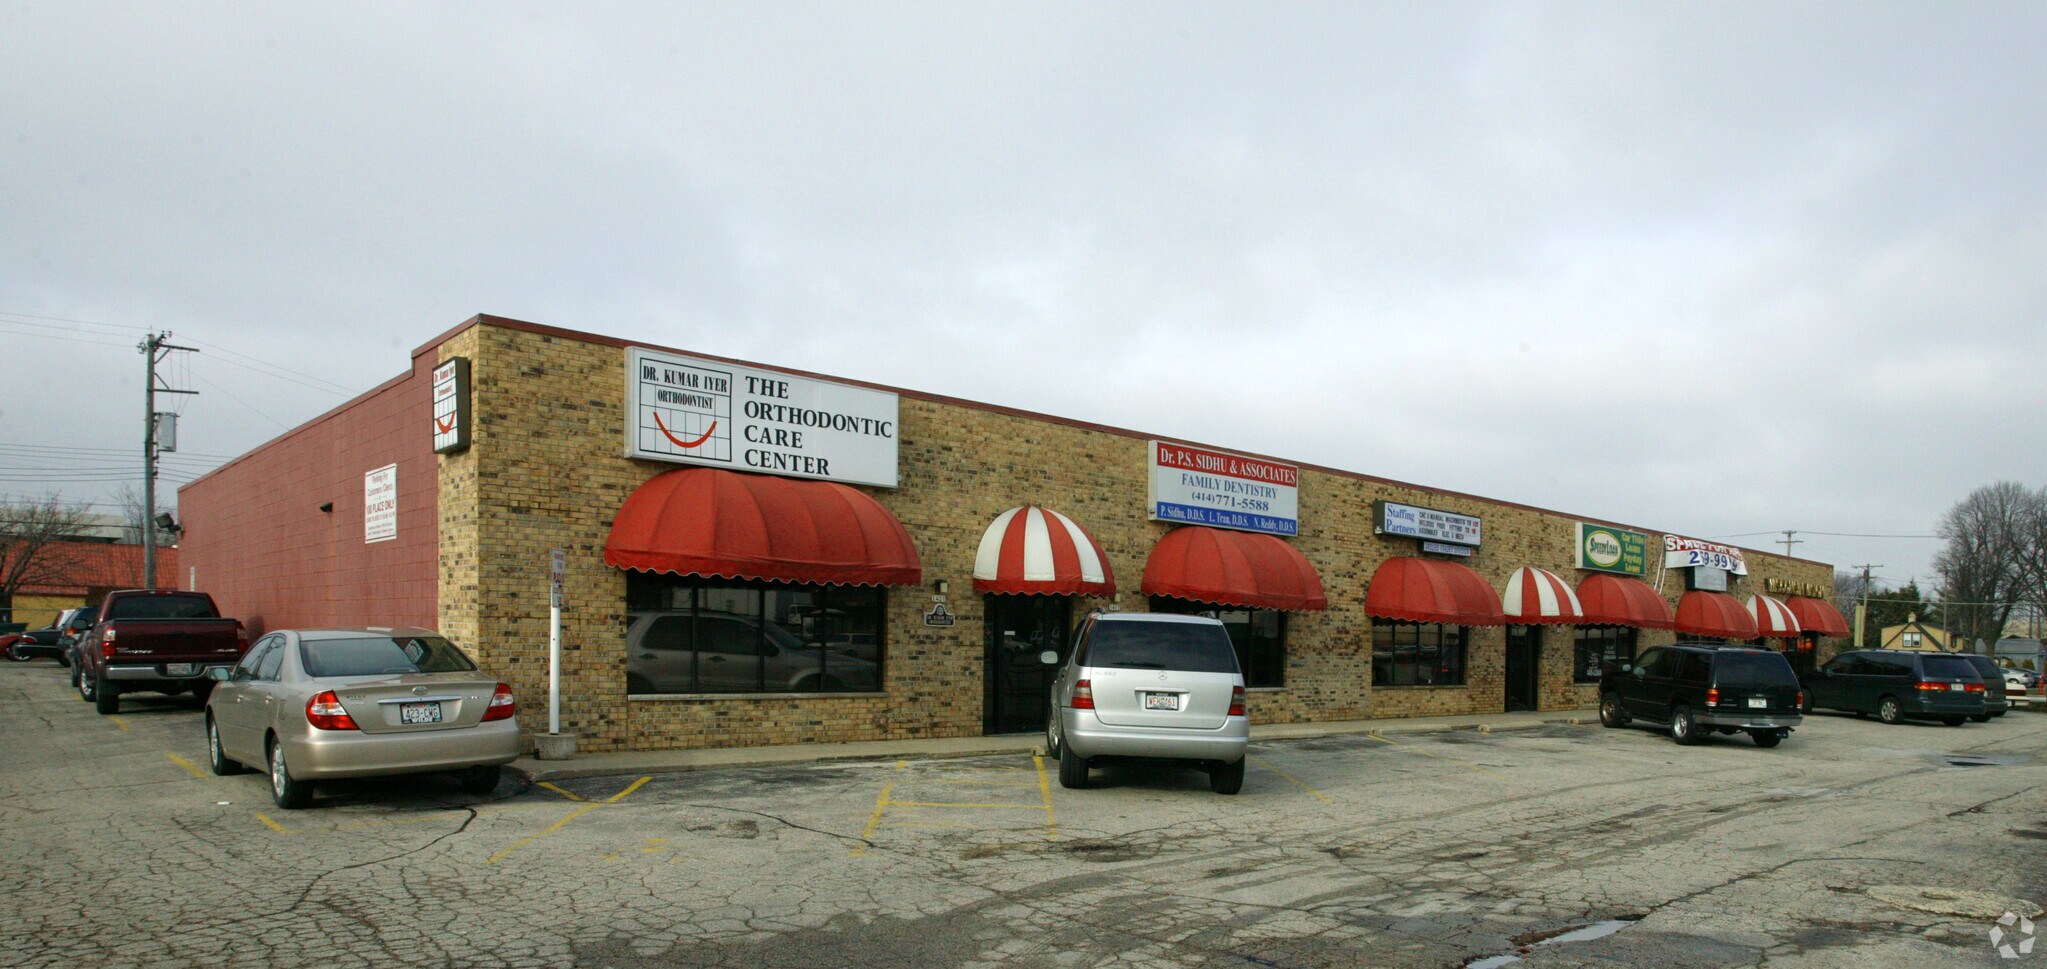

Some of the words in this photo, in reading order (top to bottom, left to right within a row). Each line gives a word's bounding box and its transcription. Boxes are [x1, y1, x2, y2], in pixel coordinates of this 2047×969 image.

[643, 365, 660, 382] DR.
[664, 369, 699, 388] KUMAR
[704, 376, 728, 393] IYER
[745, 376, 789, 400] THE
[657, 389, 714, 410] ORTHODONTIST
[744, 400, 892, 438] ORTHODONTIC
[744, 425, 803, 449] CARE
[744, 449, 830, 476] CENTER
[1161, 448, 1175, 464] Dr.
[1178, 452, 1194, 468] P.S.
[1196, 455, 1228, 473] SIDHU
[1230, 460, 1238, 474] &
[1239, 462, 1296, 484] ASSOCIATES
[1182, 474, 1221, 490] FAMILY
[1224, 480, 1278, 499] DENTISTRY
[1161, 506, 1167, 516] P.
[1188, 509, 1205, 521] D.D.S.
[1232, 515, 1248, 527] D.D.S.
[1278, 521, 1294, 533] D.D.S.
[1387, 504, 1415, 523] Staffing
[1386, 518, 1416, 535] Partners
